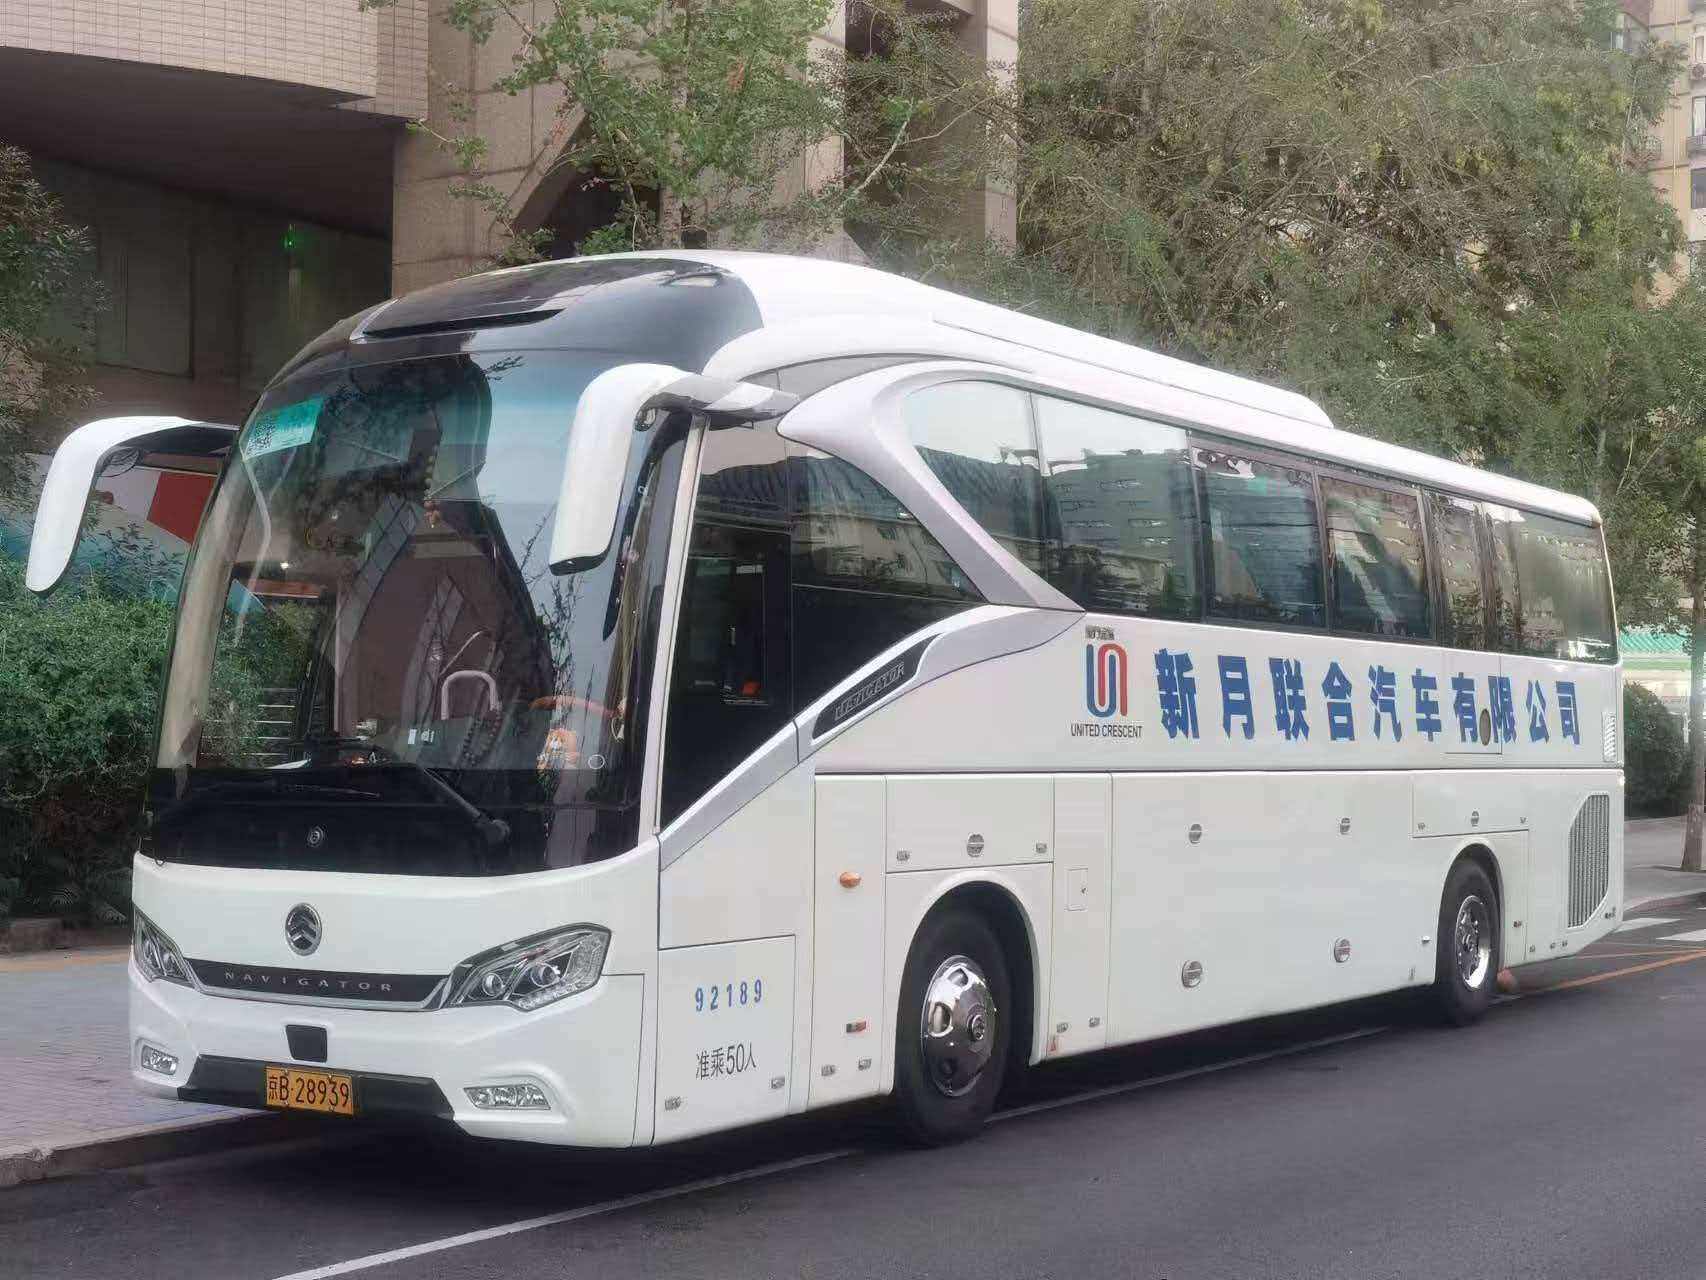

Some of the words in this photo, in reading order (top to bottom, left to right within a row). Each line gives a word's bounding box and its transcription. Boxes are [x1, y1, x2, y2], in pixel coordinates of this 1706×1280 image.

[1153, 647, 1582, 745] 新月联合汽车有限公司
[1070, 723, 1100, 737] UNITED
[1101, 724, 1143, 738] CRESCENT
[224, 971, 393, 993] NAVIGATOR
[695, 979, 762, 1012] 92189
[695, 1042, 757, 1081] 准乘50人
